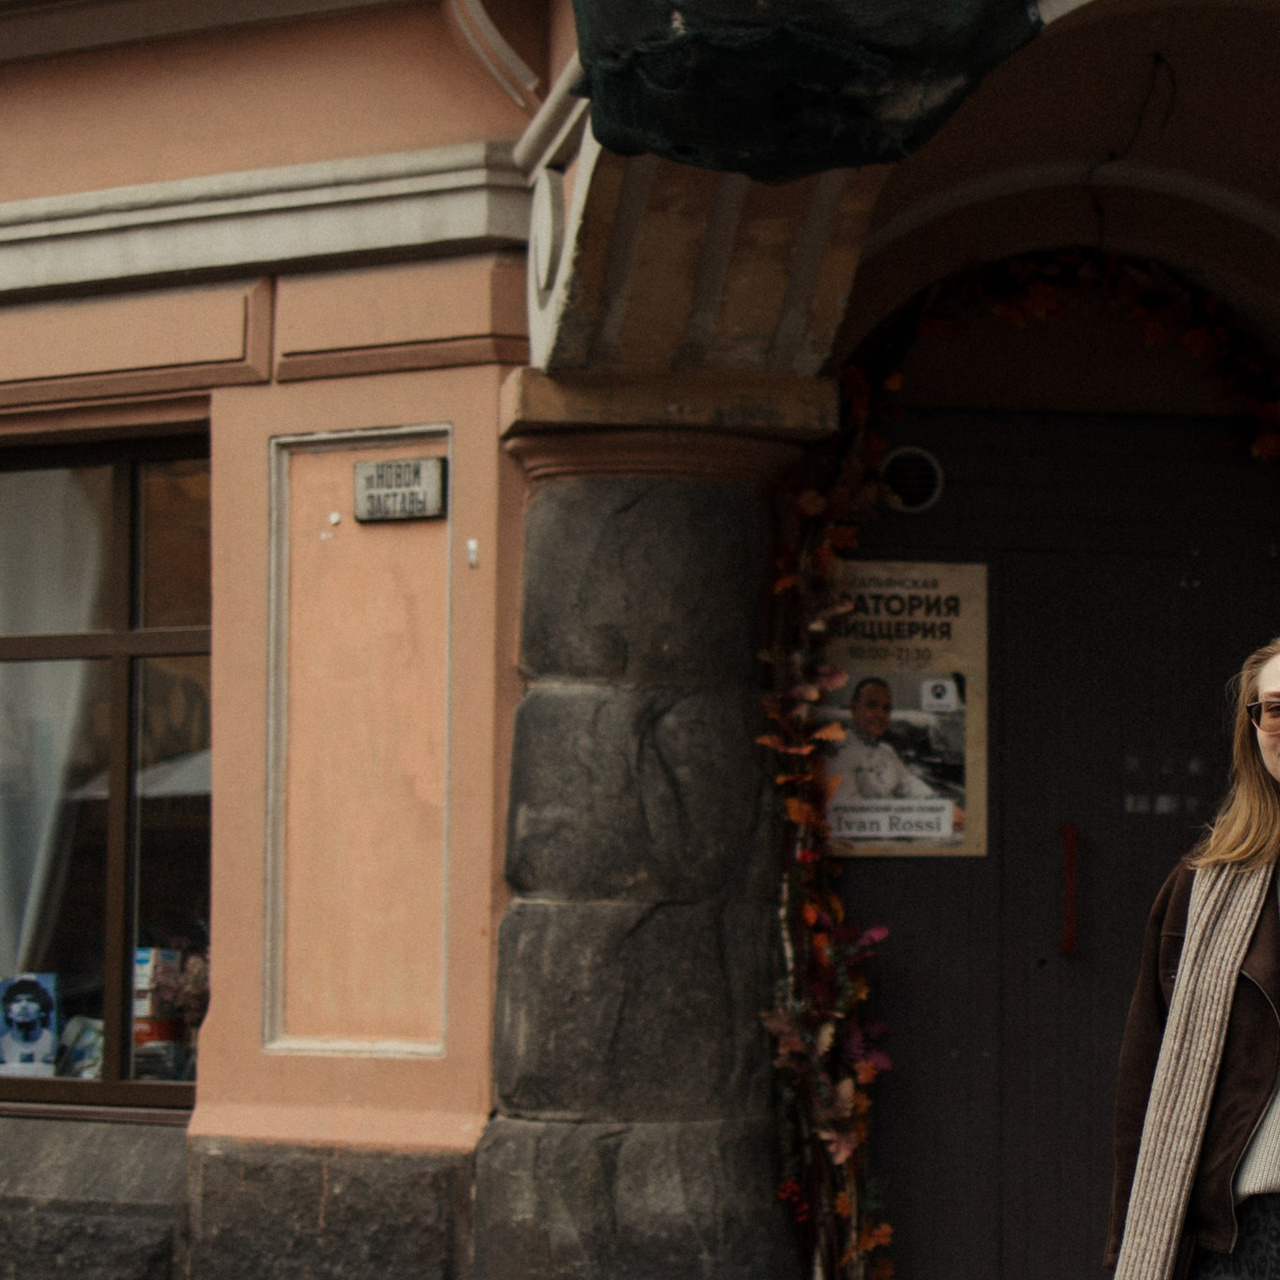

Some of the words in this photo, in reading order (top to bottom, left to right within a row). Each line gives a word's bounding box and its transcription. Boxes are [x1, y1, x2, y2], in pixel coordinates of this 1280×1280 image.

[366, 490, 427, 518] ЗАСТАВЫ
[839, 593, 960, 617] АТОРИЯ
[836, 817, 880, 832] Ivan
[888, 816, 942, 832] Rossi
